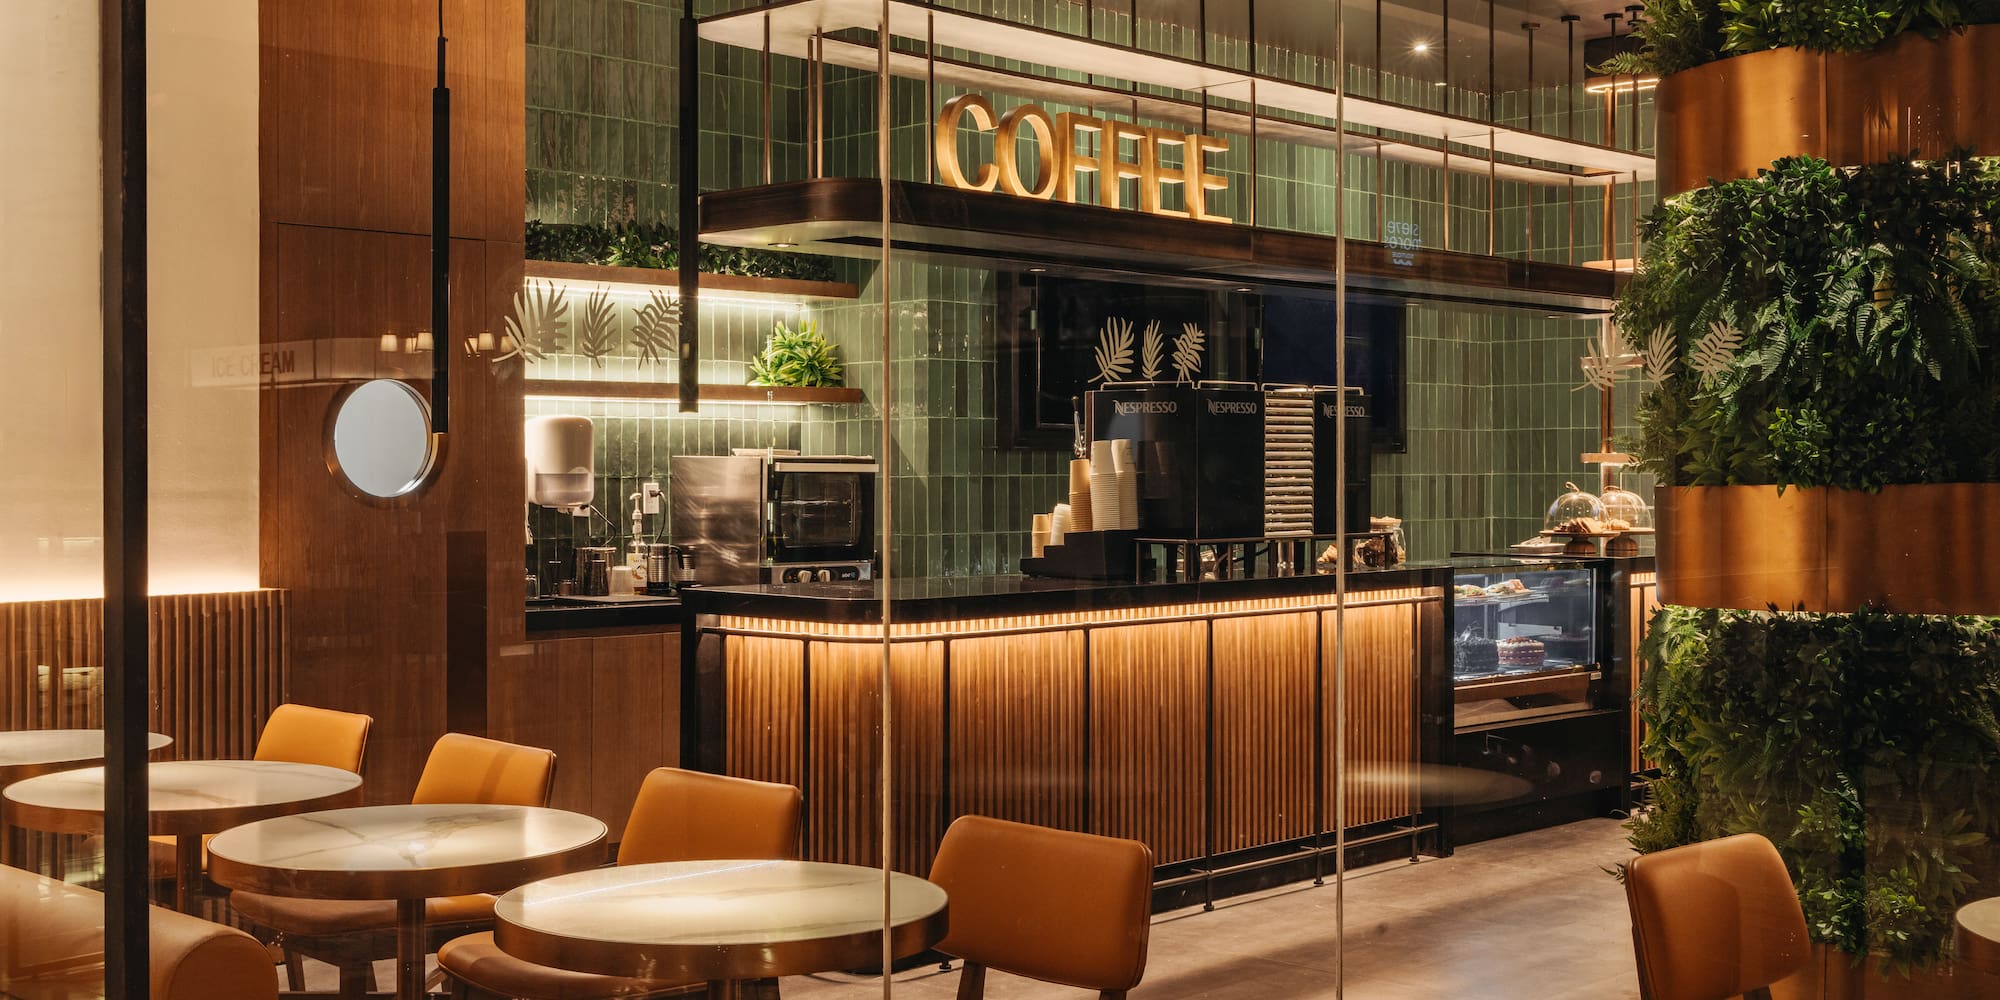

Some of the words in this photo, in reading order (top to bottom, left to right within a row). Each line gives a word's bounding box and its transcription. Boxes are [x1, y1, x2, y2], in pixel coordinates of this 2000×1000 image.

[936, 93, 1233, 225] COFFEE
[211, 354, 235, 378] ICE
[239, 350, 295, 377] CREAM
[1112, 399, 1178, 416] NESPRESSO
[1206, 398, 1257, 416] NESPRESSO
